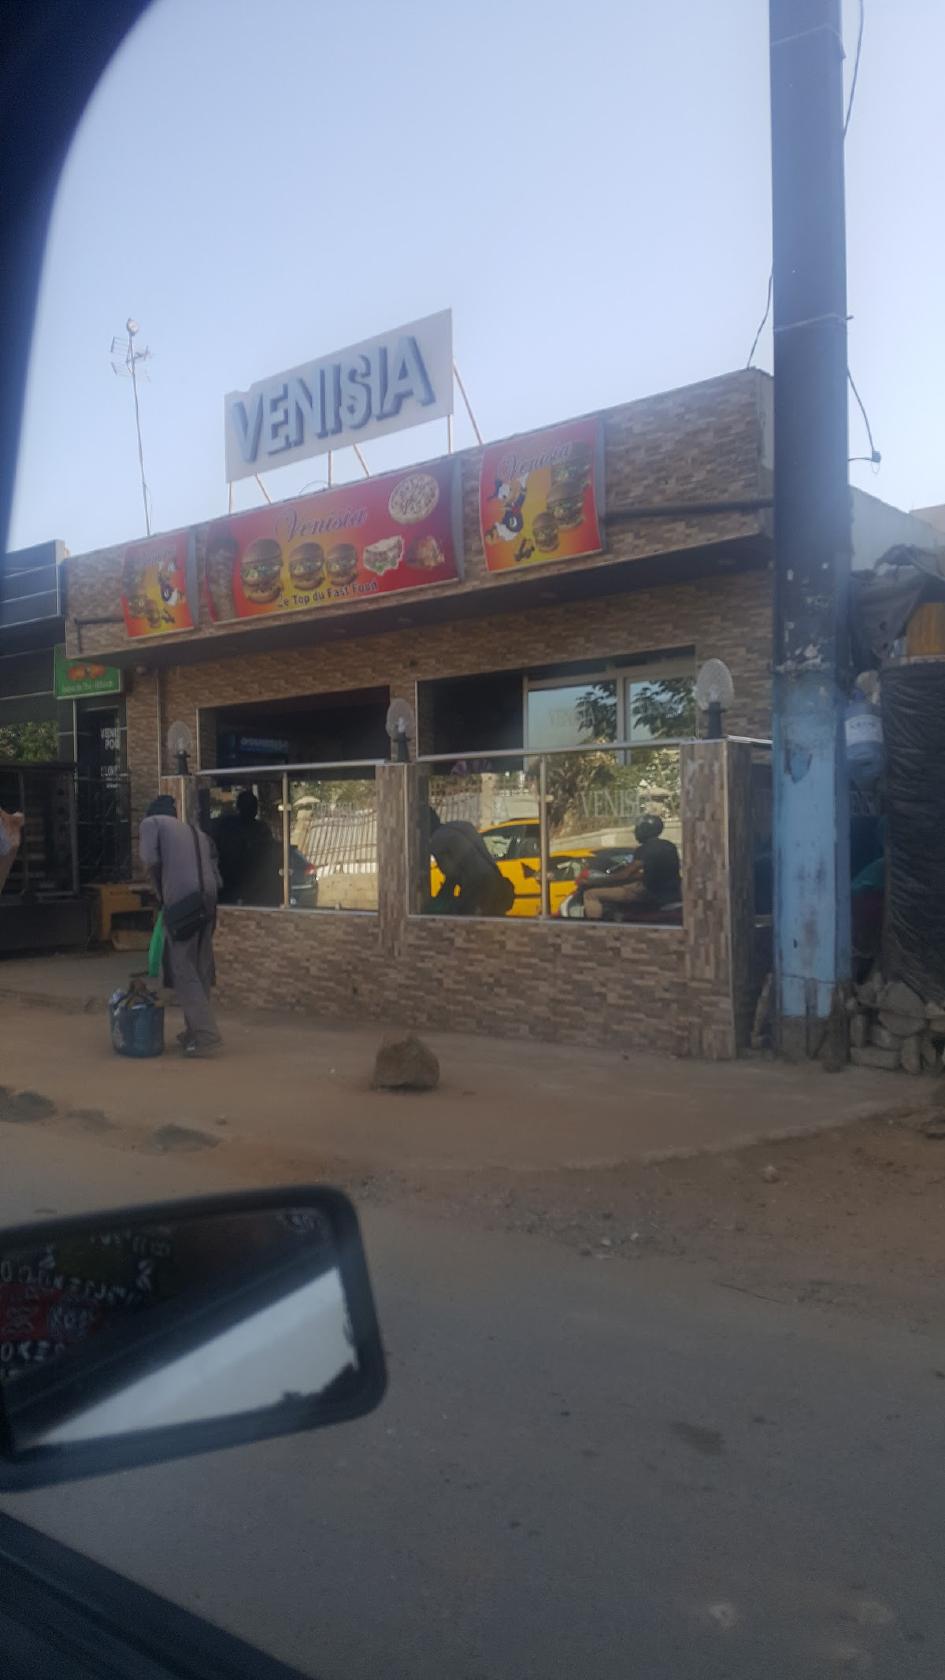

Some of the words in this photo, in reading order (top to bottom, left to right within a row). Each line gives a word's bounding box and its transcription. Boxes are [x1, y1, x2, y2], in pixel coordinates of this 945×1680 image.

[231, 335, 436, 464] VENISIA
[292, 593, 310, 607] Top
[313, 590, 325, 601] du
[327, 585, 349, 600] Fast
